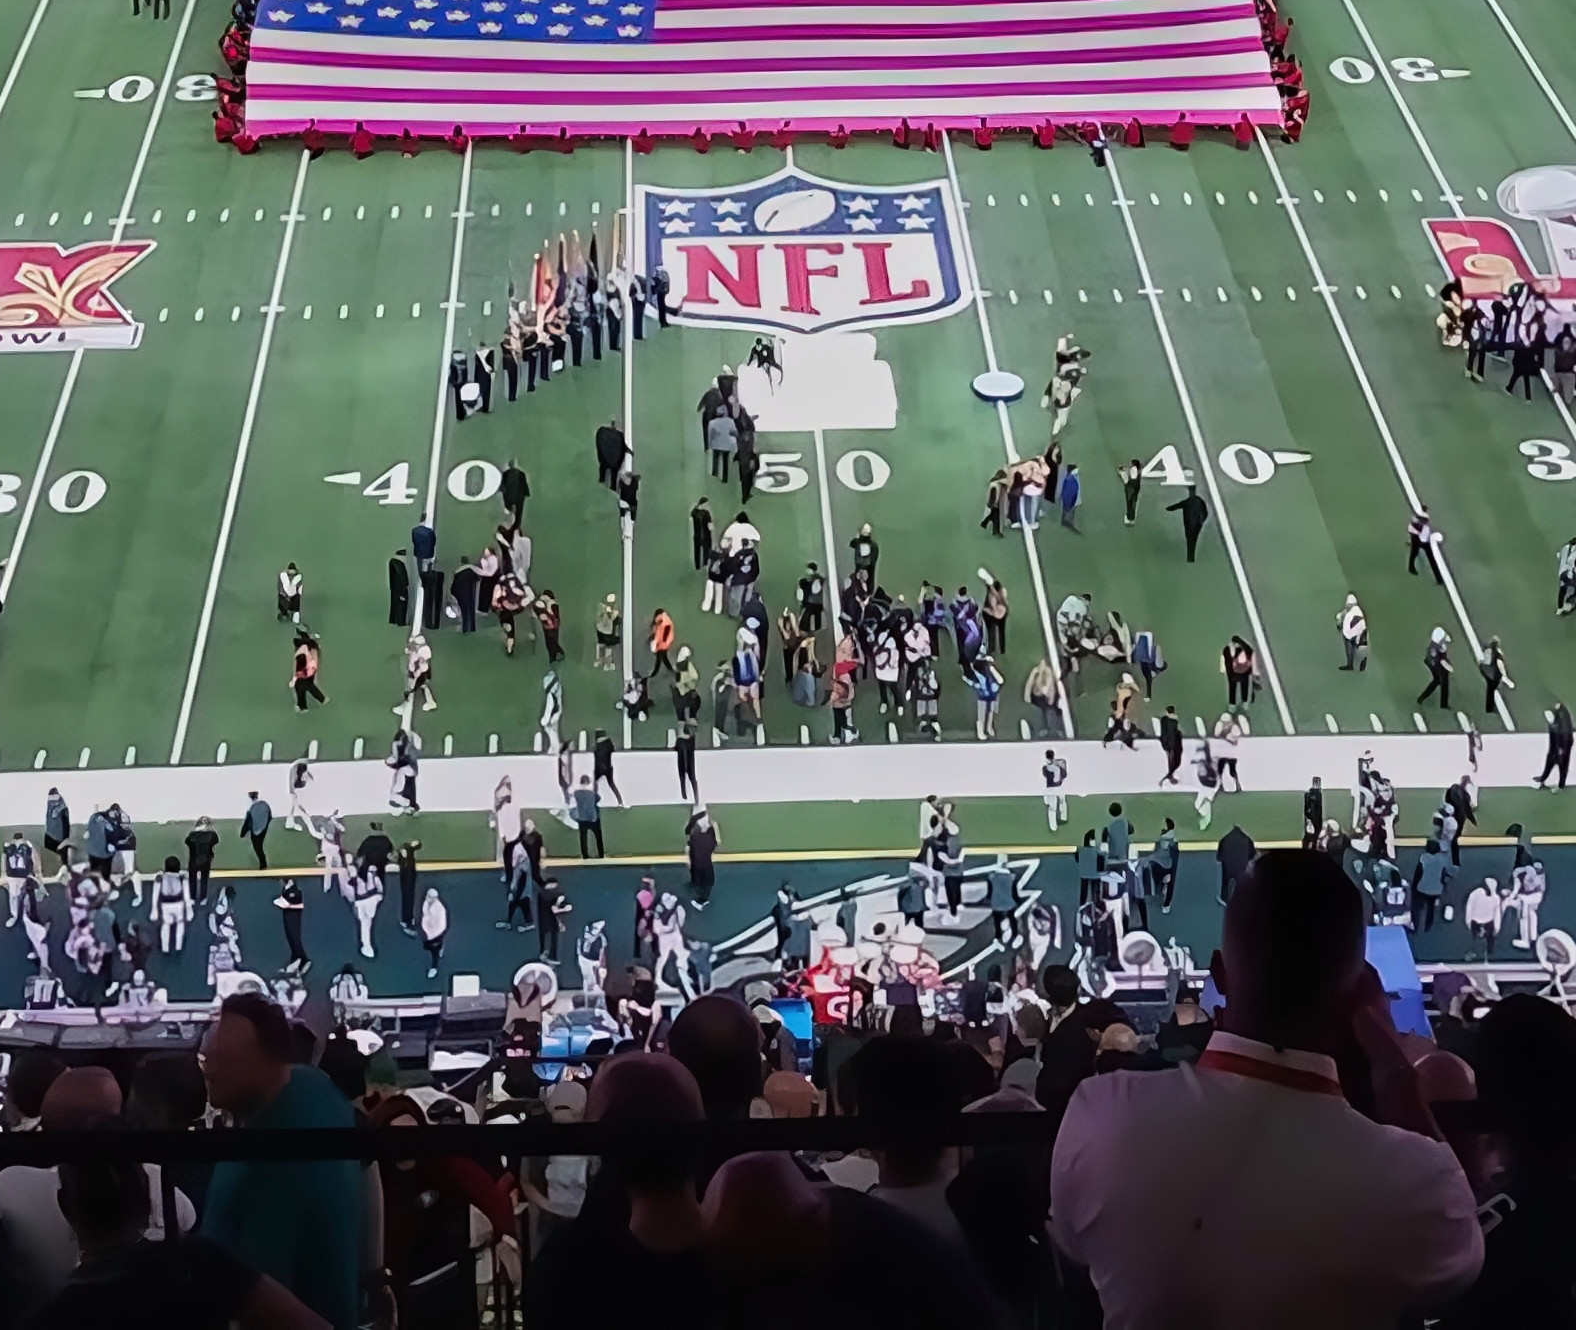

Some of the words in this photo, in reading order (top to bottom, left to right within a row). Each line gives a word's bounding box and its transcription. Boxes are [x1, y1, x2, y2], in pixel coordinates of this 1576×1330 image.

[678, 241, 931, 315] NFL
[362, 460, 504, 506] 40
[753, 448, 891, 494] 50
[1140, 441, 1277, 488] 40
